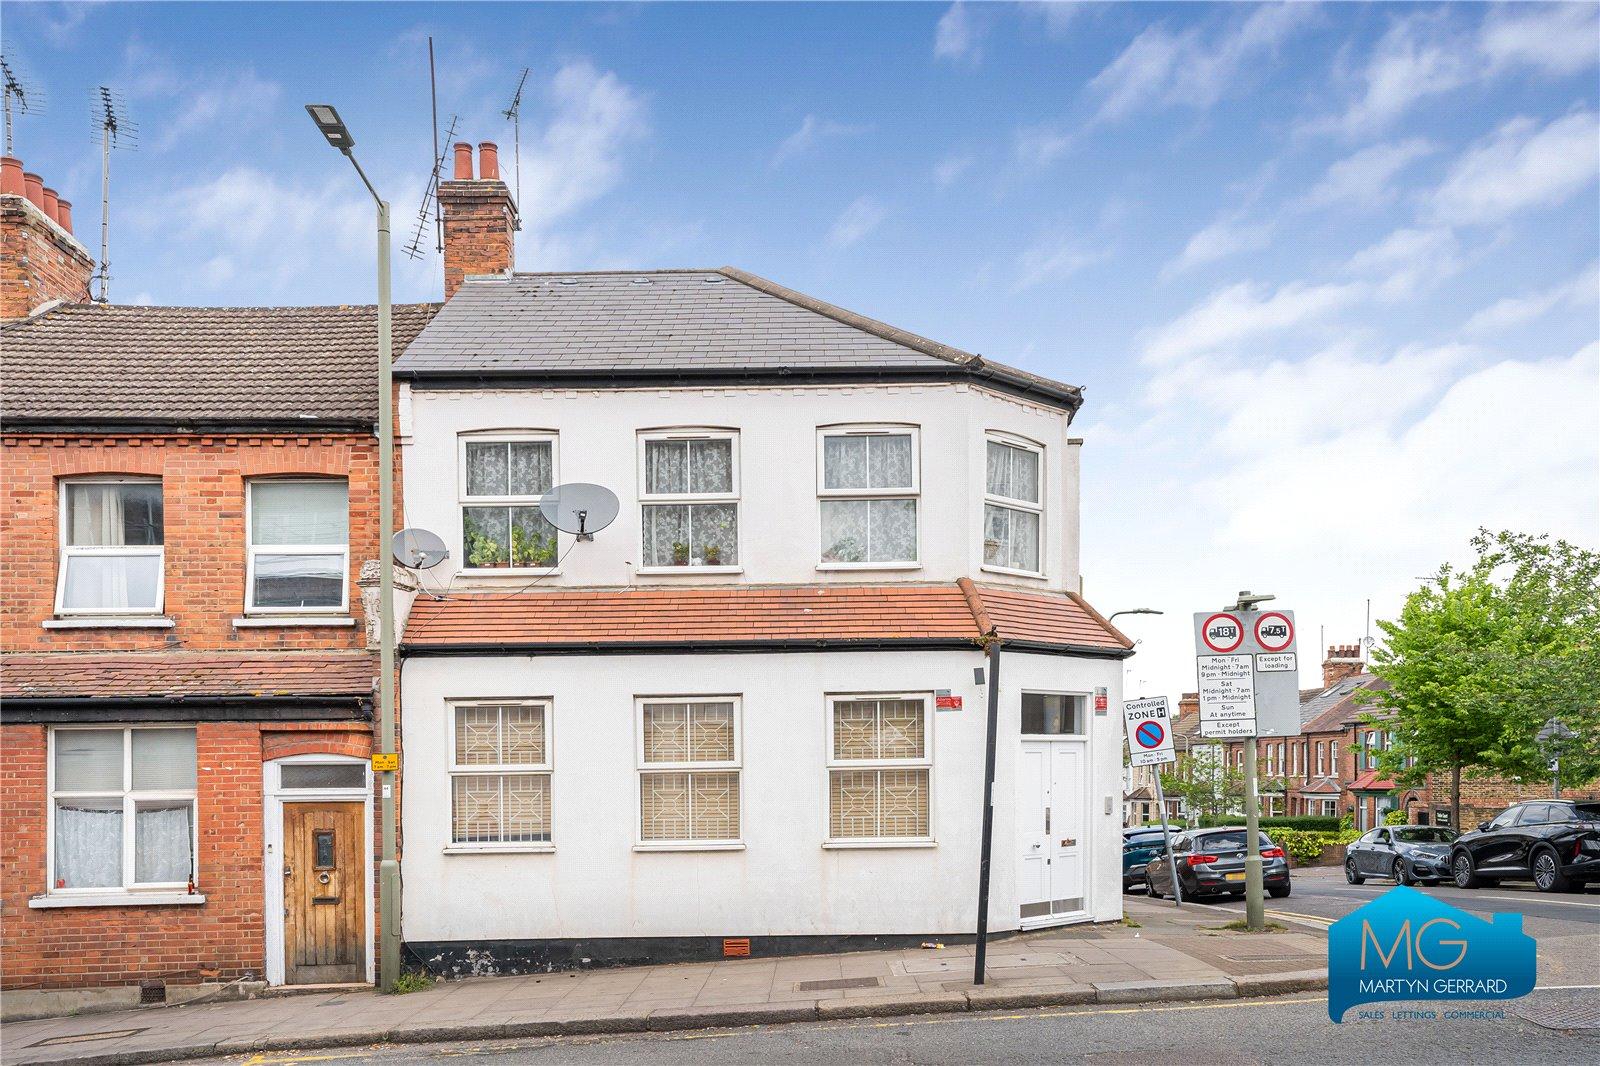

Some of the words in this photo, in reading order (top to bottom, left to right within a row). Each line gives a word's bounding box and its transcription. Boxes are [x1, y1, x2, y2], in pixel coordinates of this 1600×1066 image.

[1264, 662, 1289, 670] loading
[1126, 700, 1165, 710] Controlled
[1128, 710, 1156, 720] ZONE
[1156, 707, 1166, 718] H
[1220, 710, 1246, 718] anytime
[1228, 727, 1253, 735] holders
